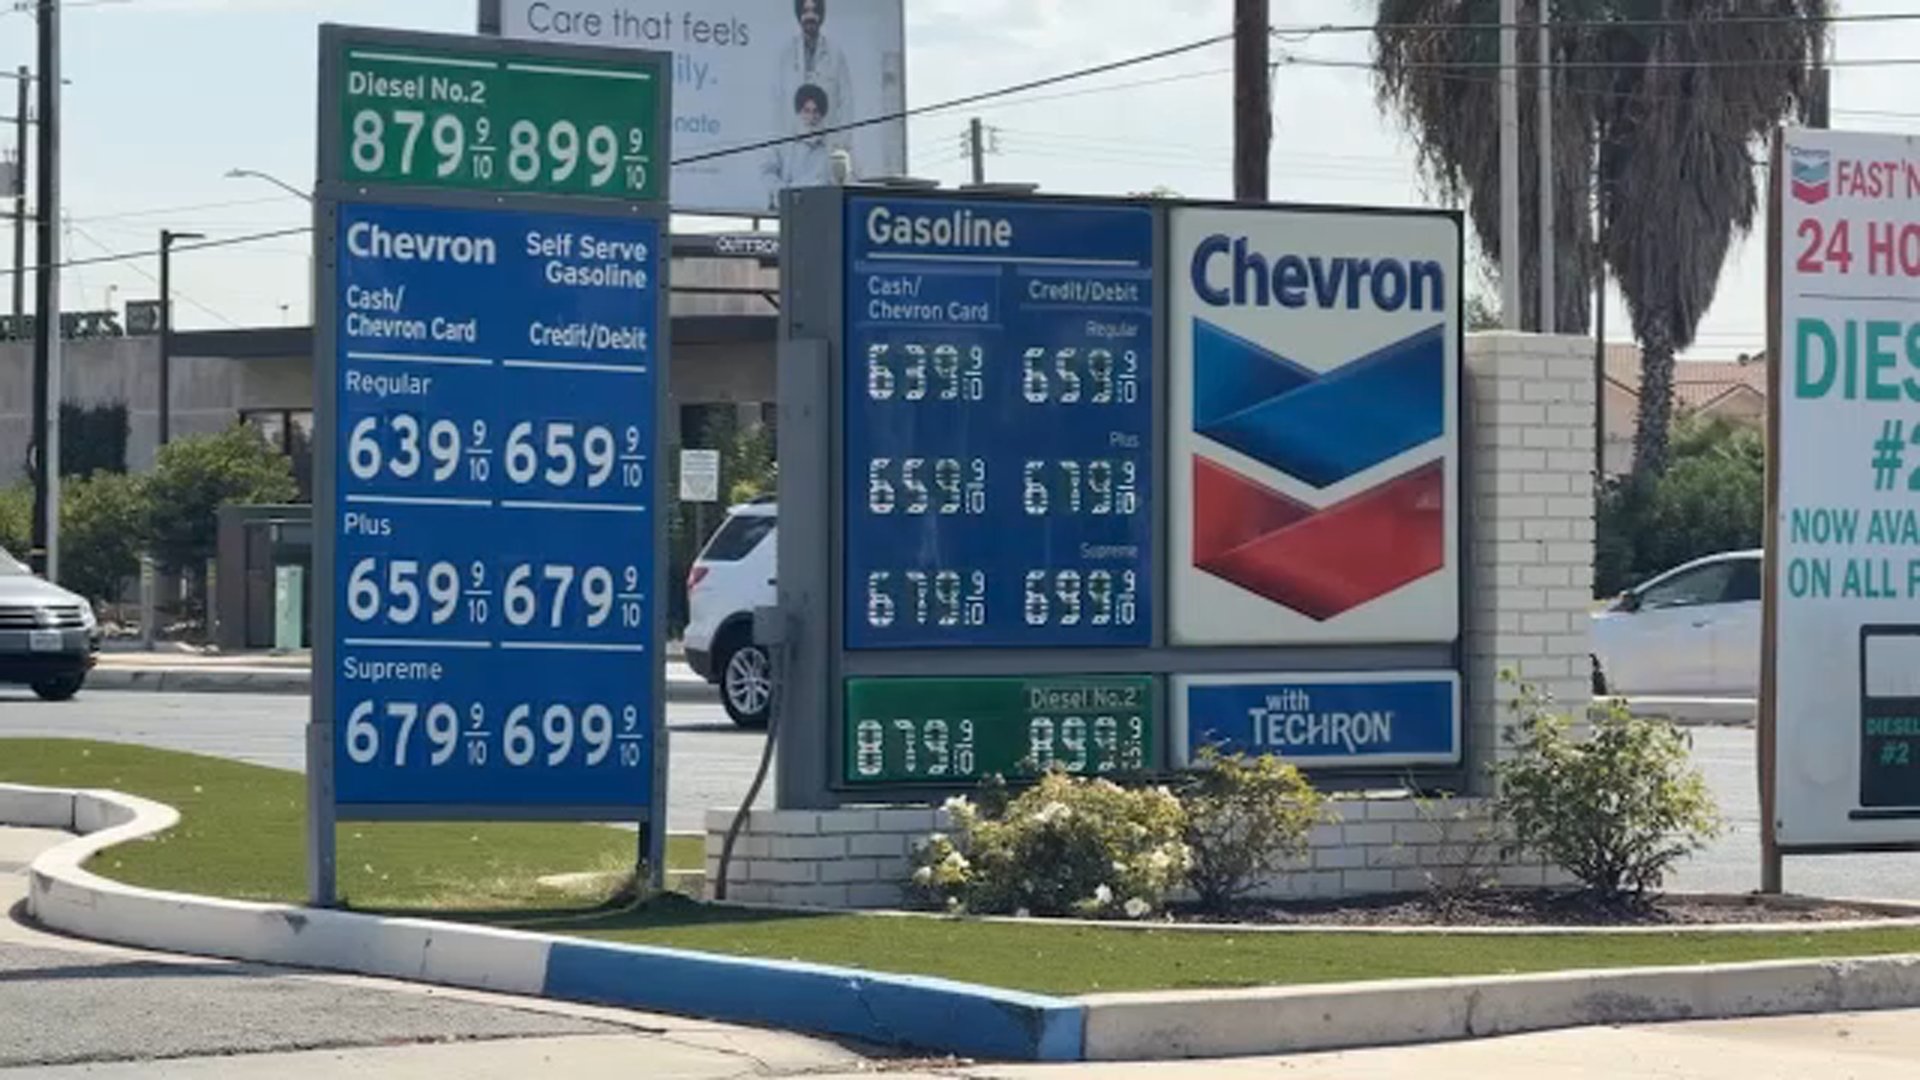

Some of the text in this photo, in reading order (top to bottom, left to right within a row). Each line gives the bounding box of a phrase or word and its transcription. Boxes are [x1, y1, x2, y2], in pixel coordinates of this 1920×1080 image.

[527, 2, 750, 46] Care that feels
[349, 71, 486, 103] Diesel No.2
[351, 109, 465, 177] 879
[508, 119, 619, 187] 899
[347, 222, 496, 264] Chevron
[526, 231, 647, 262] Self Serve
[867, 207, 1012, 247] Gasoline
[1796, 219, 1920, 277] 24 HO
[545, 259, 647, 289] Gasoline
[868, 276, 922, 297] Cash/
[1028, 280, 1138, 301] Credit/Debit
[1190, 233, 1445, 312] Chevron
[346, 285, 404, 312] Cash/
[868, 299, 989, 321] Chevron Card
[346, 313, 476, 343] Chevron Card
[529, 322, 647, 350] Credit/Debit
[1085, 320, 1138, 338] Regular
[346, 371, 431, 397] Regular
[868, 344, 959, 400] 639
[1023, 348, 1113, 403] 659
[350, 414, 461, 482] 639
[505, 421, 615, 488] 659
[1109, 431, 1140, 448] Plus
[869, 458, 961, 514] 659
[1024, 461, 1112, 514] 679
[344, 513, 392, 536] Plus
[1791, 508, 1920, 544] NOW AVA
[1080, 542, 1139, 560] Supreme
[348, 557, 460, 624] 659
[503, 563, 614, 627] 679
[1024, 570, 1112, 625] 699
[1788, 558, 1831, 598] ON
[1841, 558, 1897, 598] ALL
[868, 571, 961, 626] 679
[344, 656, 443, 682] Supreme
[1031, 687, 1136, 708] Diesel No.2
[1265, 688, 1309, 711] with
[346, 700, 459, 766] 679
[503, 703, 614, 766] 699
[1030, 716, 1117, 771] 899
[1249, 708, 1391, 753] TECHRON
[1866, 717, 1920, 735] DIESEL
[857, 719, 949, 775] 879
[1880, 741, 1909, 764] #2
